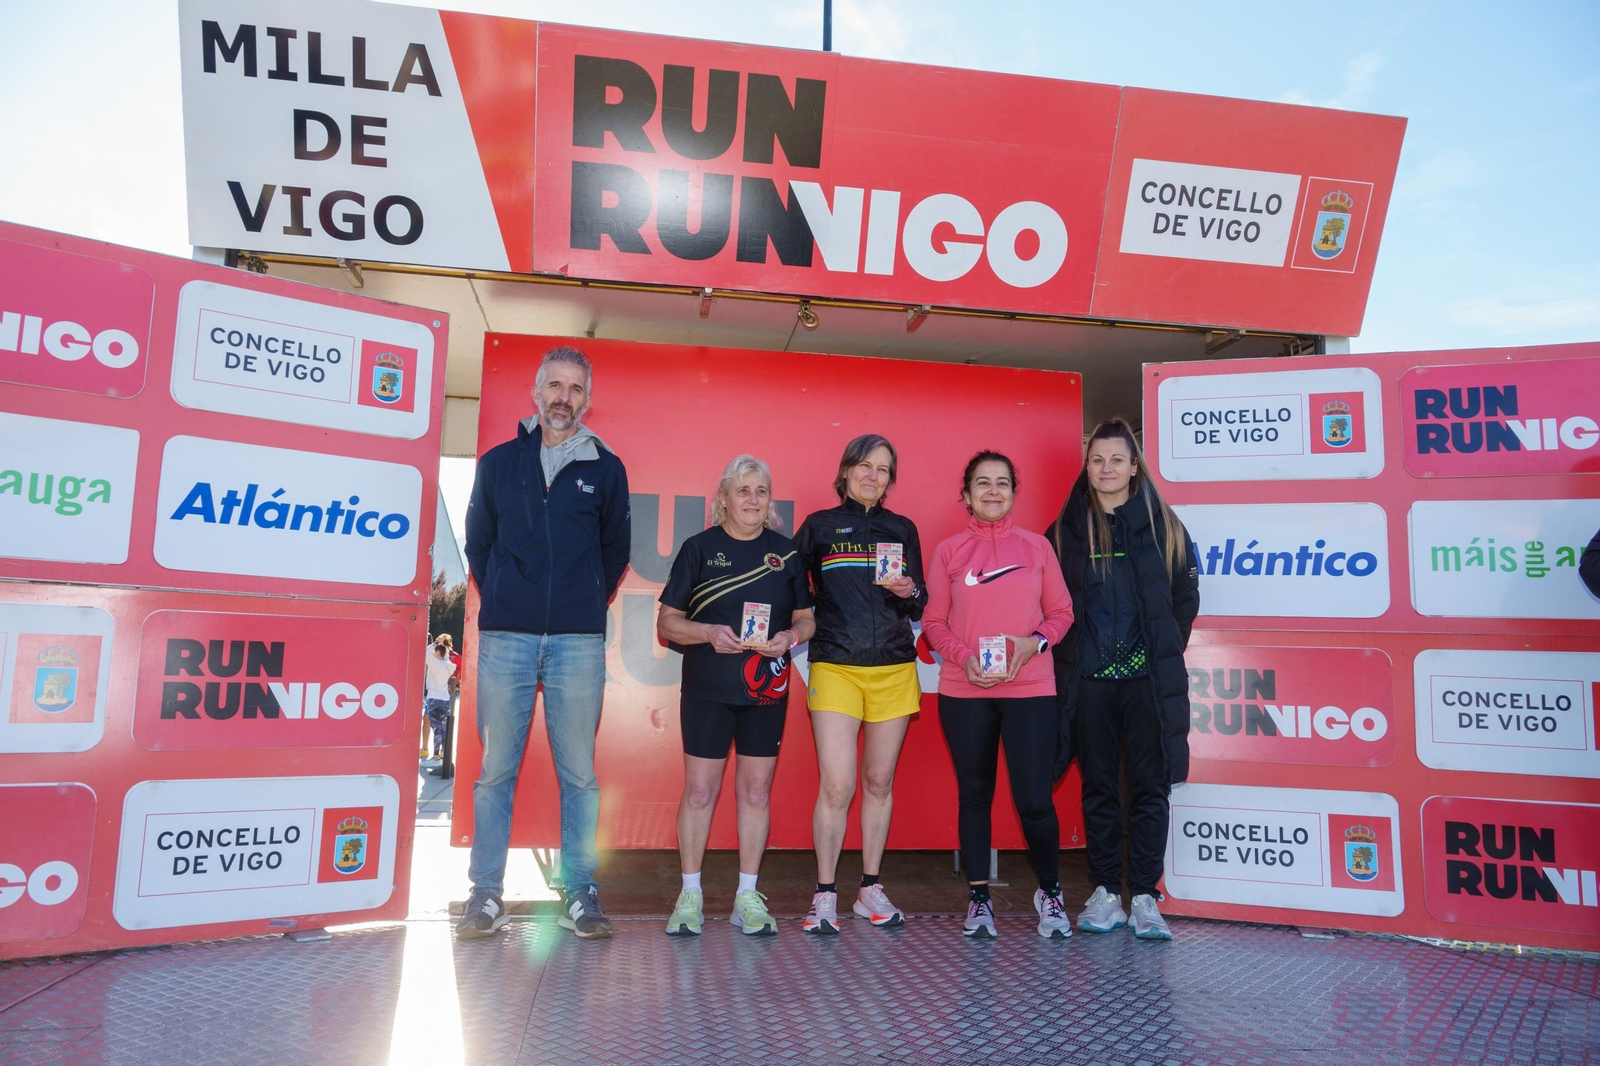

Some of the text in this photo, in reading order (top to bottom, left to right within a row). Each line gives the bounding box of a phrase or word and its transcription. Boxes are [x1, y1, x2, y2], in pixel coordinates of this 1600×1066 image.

[201, 19, 443, 98] MILLA
[572, 54, 827, 169] RUN
[292, 108, 389, 168] DE
[226, 180, 424, 246] VIGO
[1142, 182, 1282, 215] CONCELLO
[1153, 212, 1261, 243] DE VIGO
[209, 326, 342, 365] CONCELLO
[224, 352, 326, 384] DE VIGO
[1180, 407, 1292, 427] CONCELLO
[1414, 385, 1518, 419] RUN
[1194, 427, 1279, 445] DE VIGO
[0, 469, 112, 516] auga
[169, 481, 411, 541] Atlántico
[1431, 536, 1588, 578] máis que a
[164, 638, 285, 678] RUN
[1186, 667, 1276, 700] RUN
[1442, 690, 1572, 712] CONCELLO
[1458, 712, 1557, 733] DE VIGO
[156, 826, 301, 851] CONCELLO
[1182, 820, 1309, 845] CONCELLO
[1445, 820, 1556, 863] RUN
[172, 851, 283, 876] DE VIGO
[1198, 845, 1295, 868] DE VIGO
[1541, 866, 1600, 907] VI
